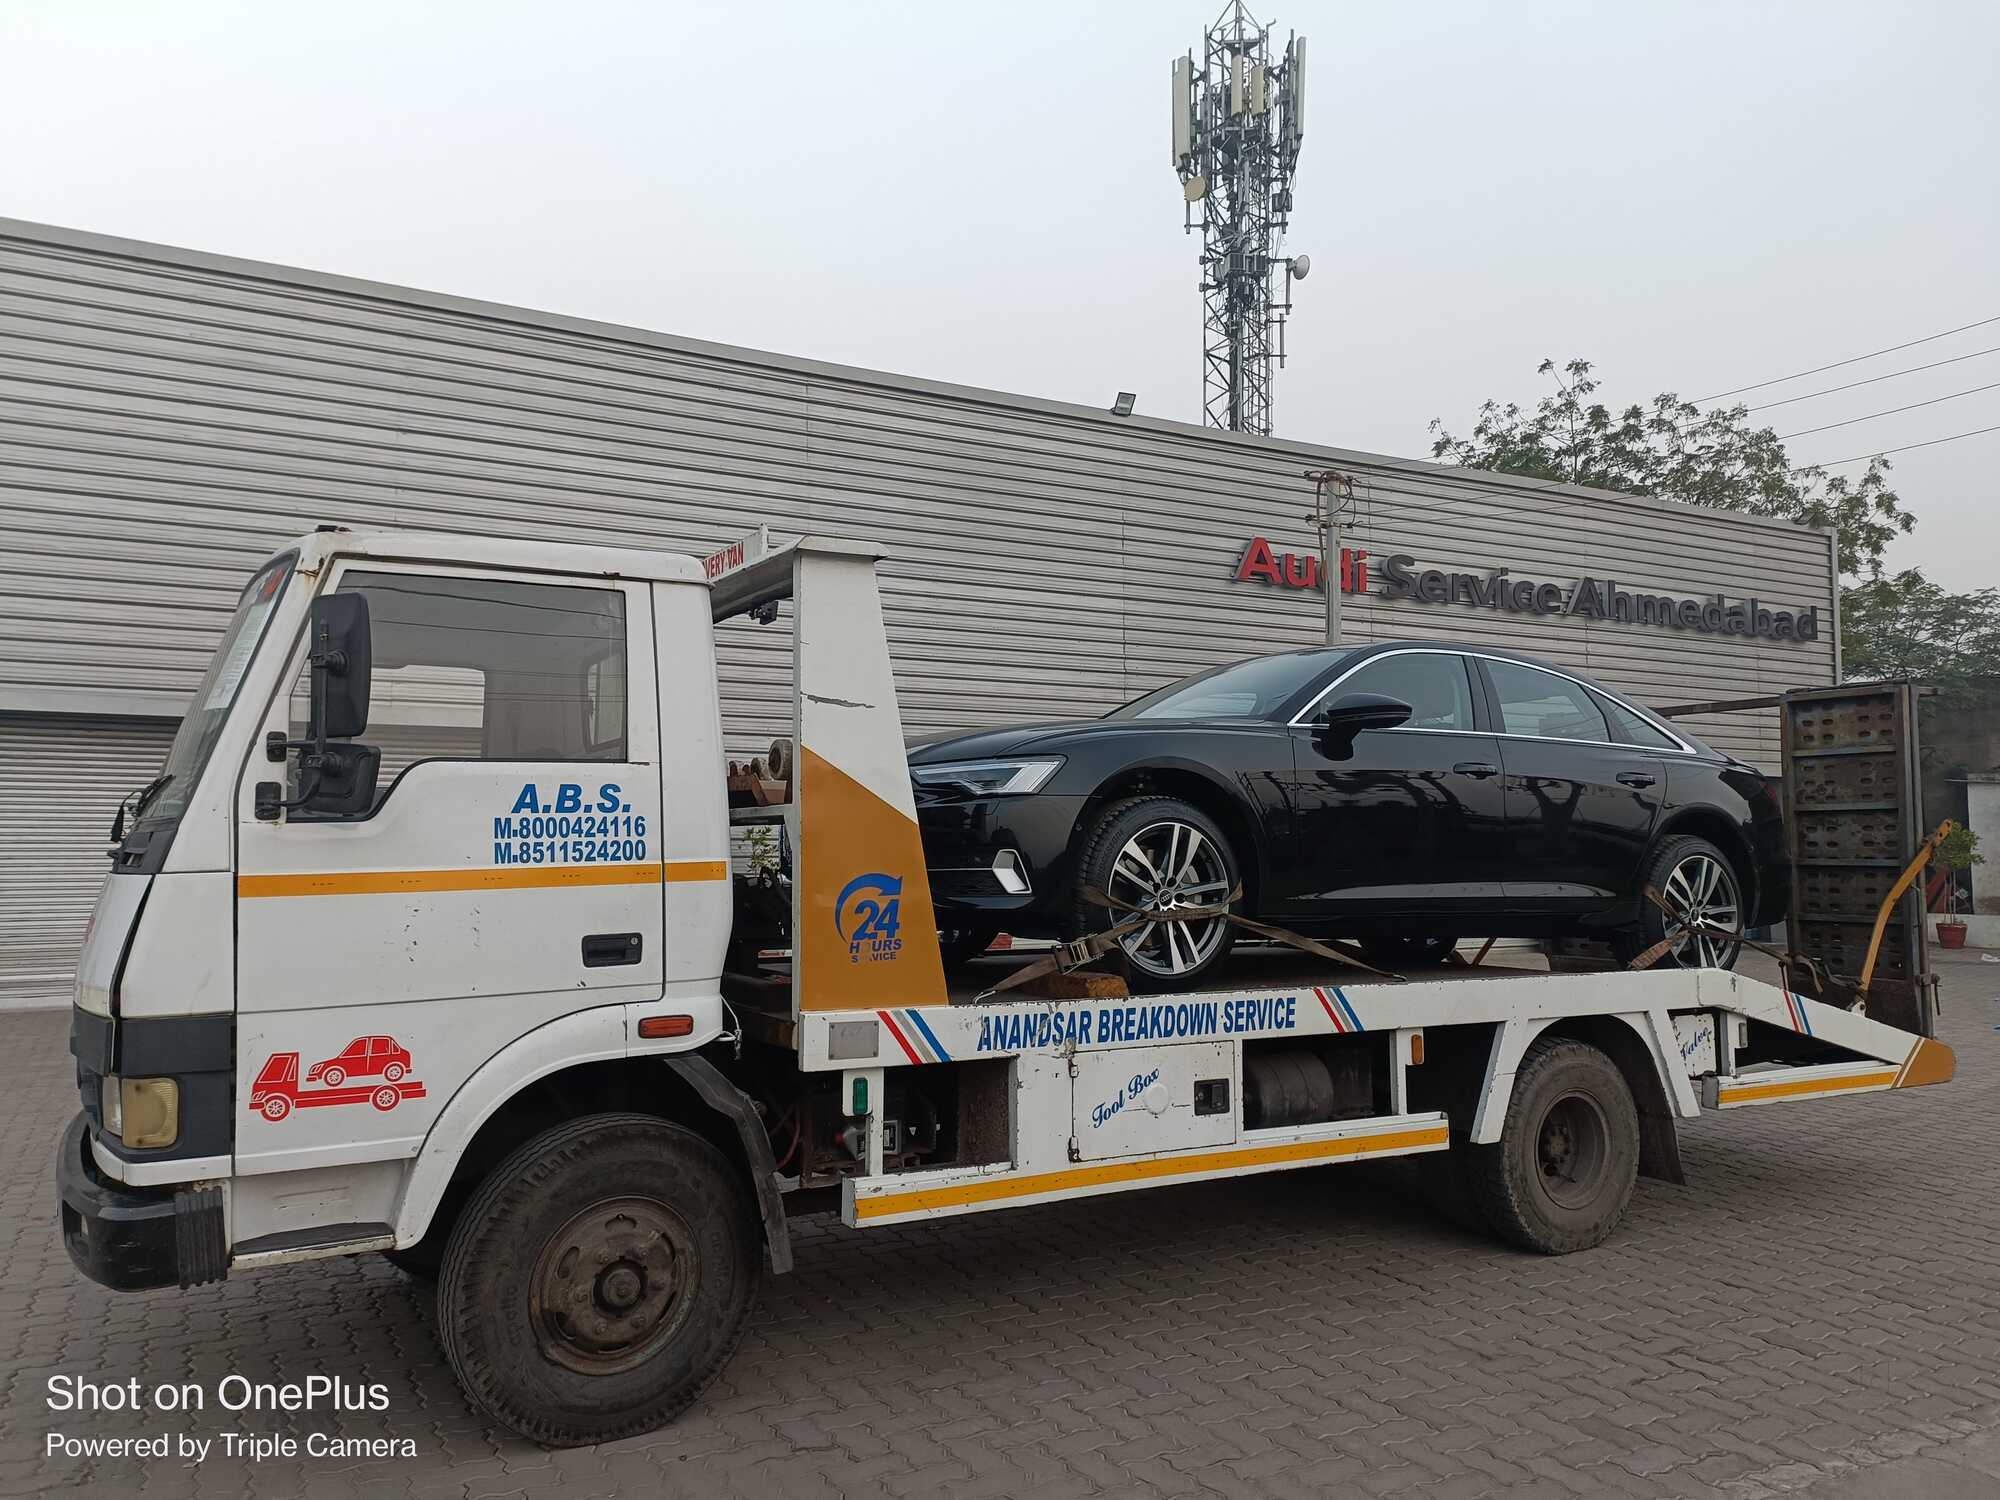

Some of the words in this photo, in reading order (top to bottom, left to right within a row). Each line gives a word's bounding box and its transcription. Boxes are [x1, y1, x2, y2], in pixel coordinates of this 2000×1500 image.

[703, 550, 725, 579] VERY
[727, 541, 744, 569] VAN
[1382, 554, 1562, 613] Service
[1565, 576, 1819, 641] Ahmedabad
[511, 783, 632, 814] A.B.S.
[494, 816, 647, 839] M.8000424116
[494, 840, 647, 865] M.8511524200
[852, 898, 900, 941] 24
[849, 938, 903, 954] HURS
[851, 951, 897, 963] SVICE
[977, 1011, 1093, 1052] ANANDSAR
[1097, 1002, 1218, 1043] BREAKDOWN
[1222, 997, 1297, 1033] SERVICE
[1091, 1089, 1126, 1129] Tool
[1128, 1067, 1160, 1101] Box
